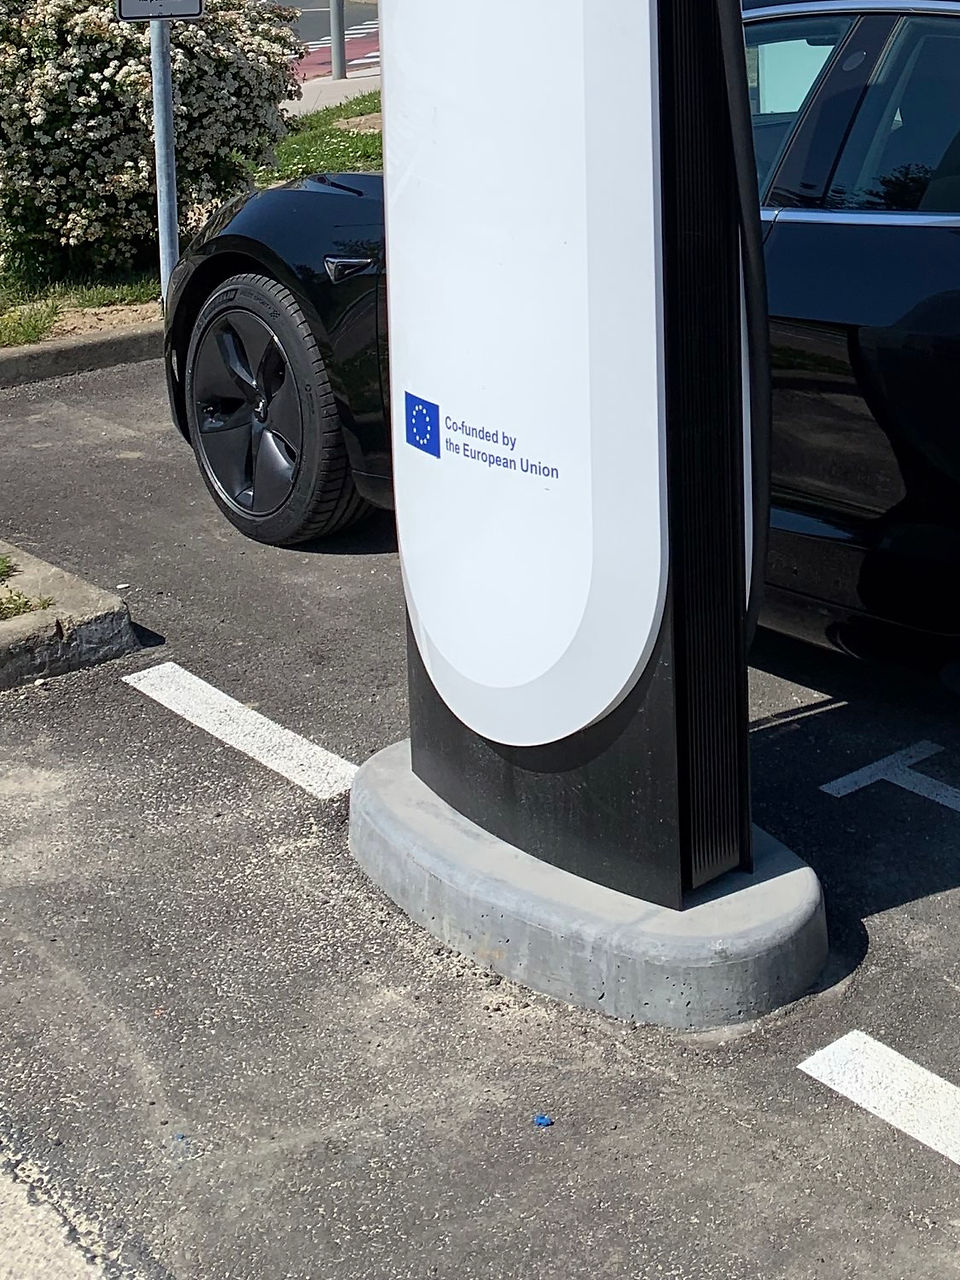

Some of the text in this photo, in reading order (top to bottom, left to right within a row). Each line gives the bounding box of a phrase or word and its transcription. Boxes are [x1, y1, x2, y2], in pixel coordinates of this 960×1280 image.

[445, 416, 517, 451] Co-funded by
[446, 438, 559, 479] the European Union
